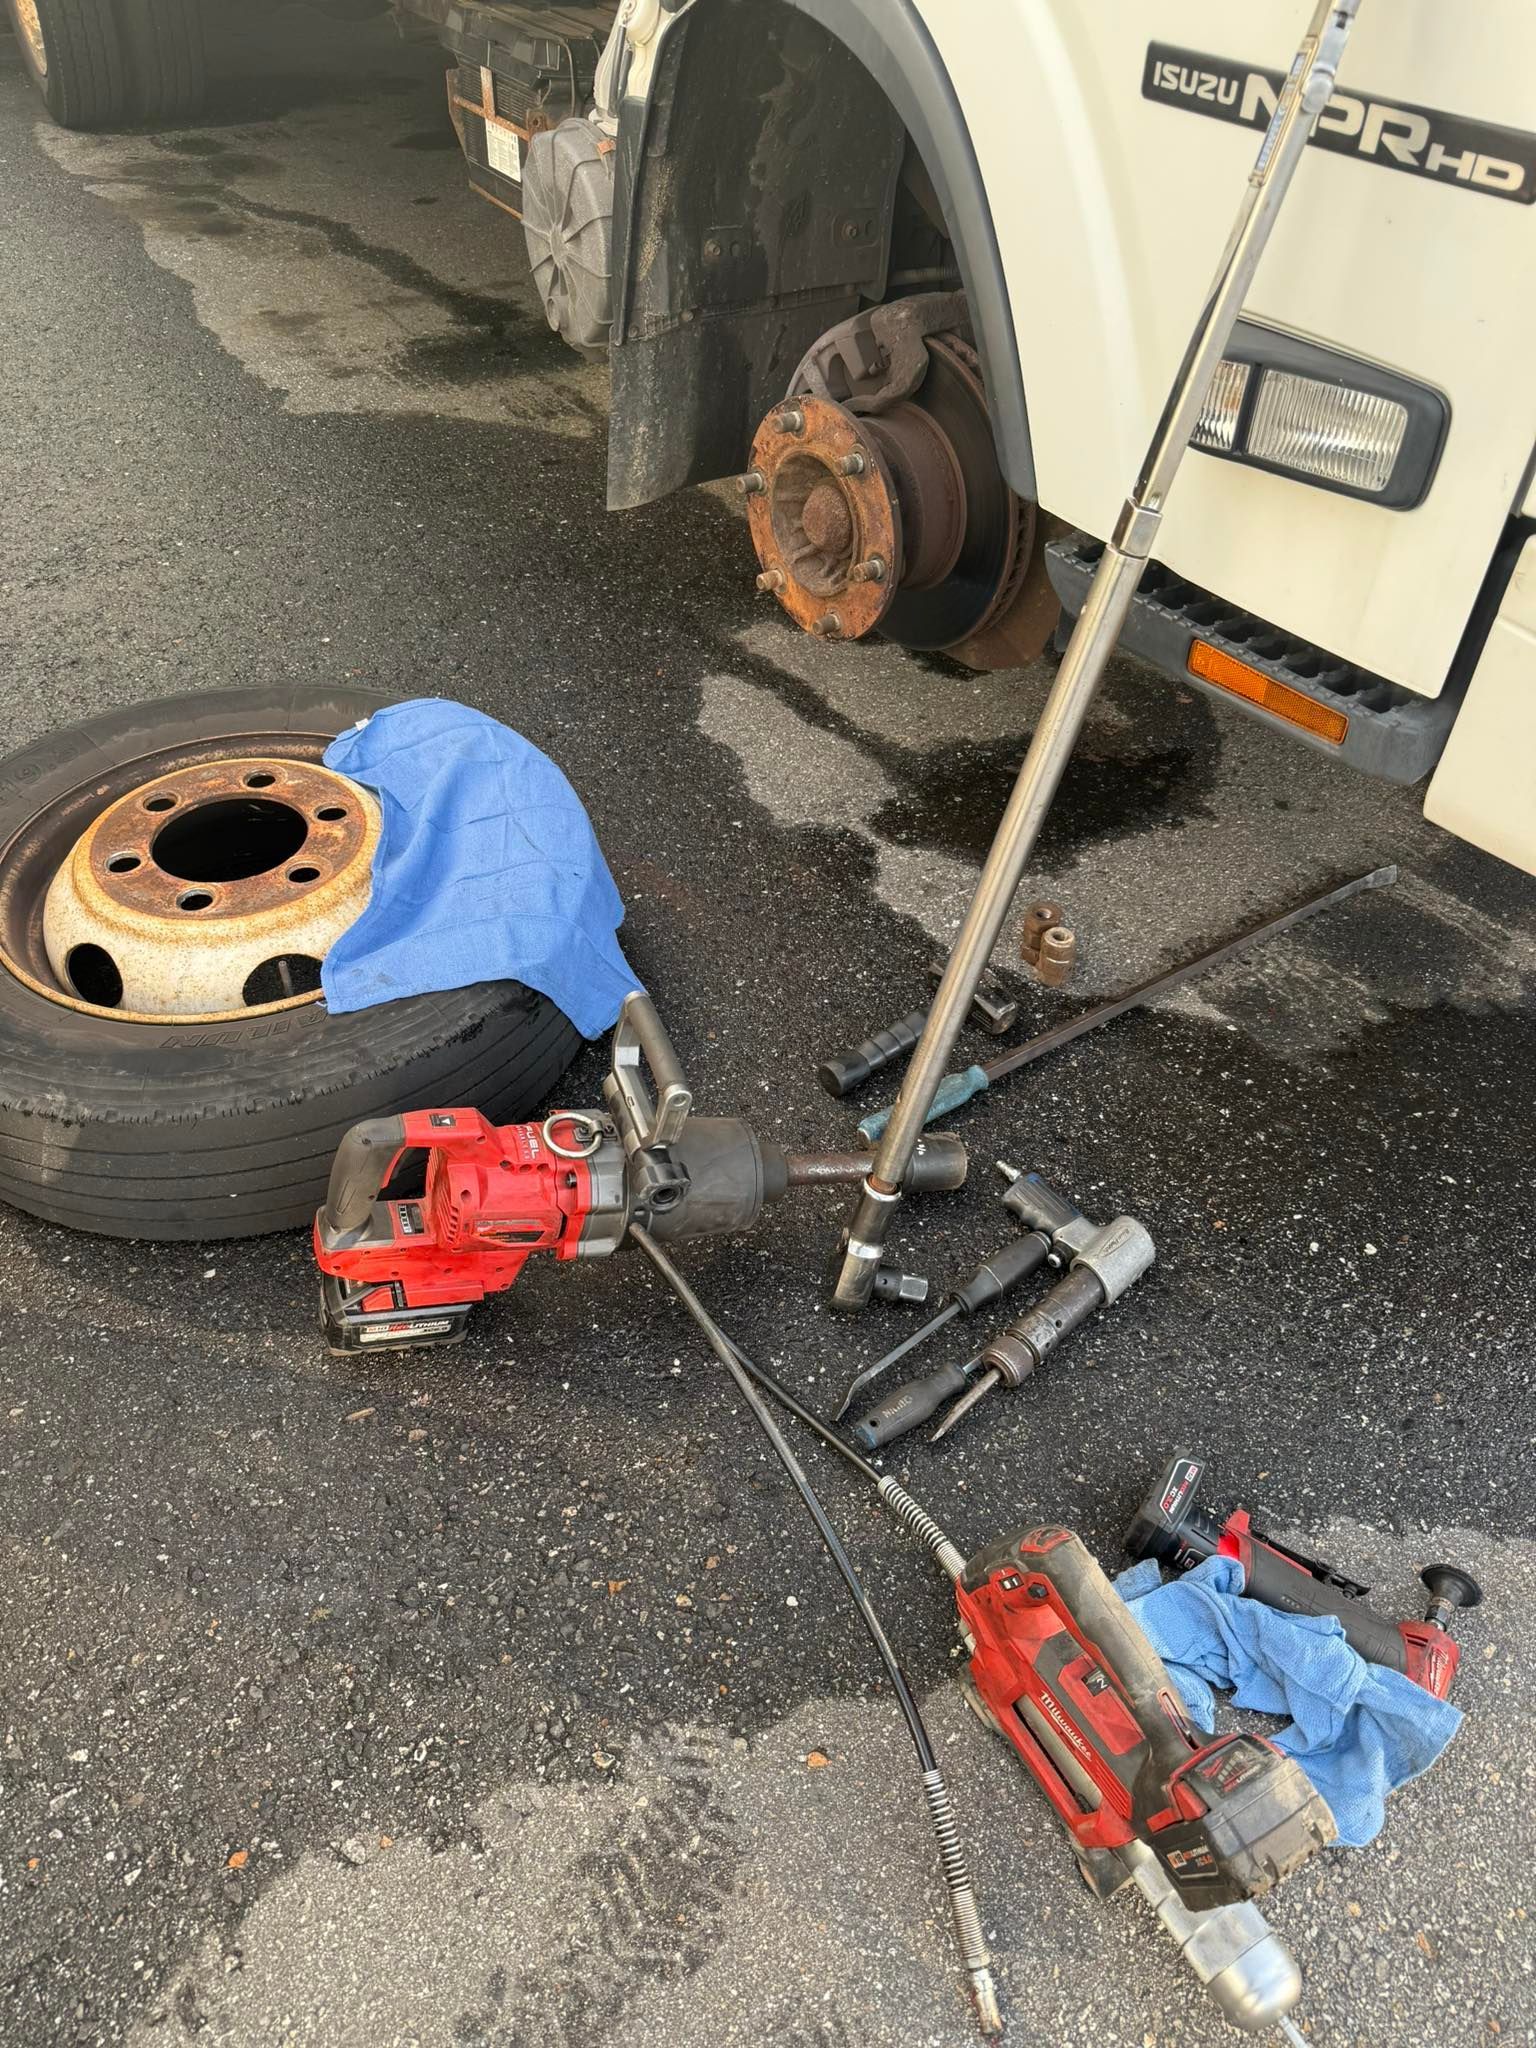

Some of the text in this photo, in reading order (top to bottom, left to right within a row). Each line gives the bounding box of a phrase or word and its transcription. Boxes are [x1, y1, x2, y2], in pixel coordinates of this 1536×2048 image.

[1152, 61, 1238, 105] ISUZU
[526, 1125, 539, 1159] FUEL
[1039, 1690, 1092, 1761] Milwaukee
